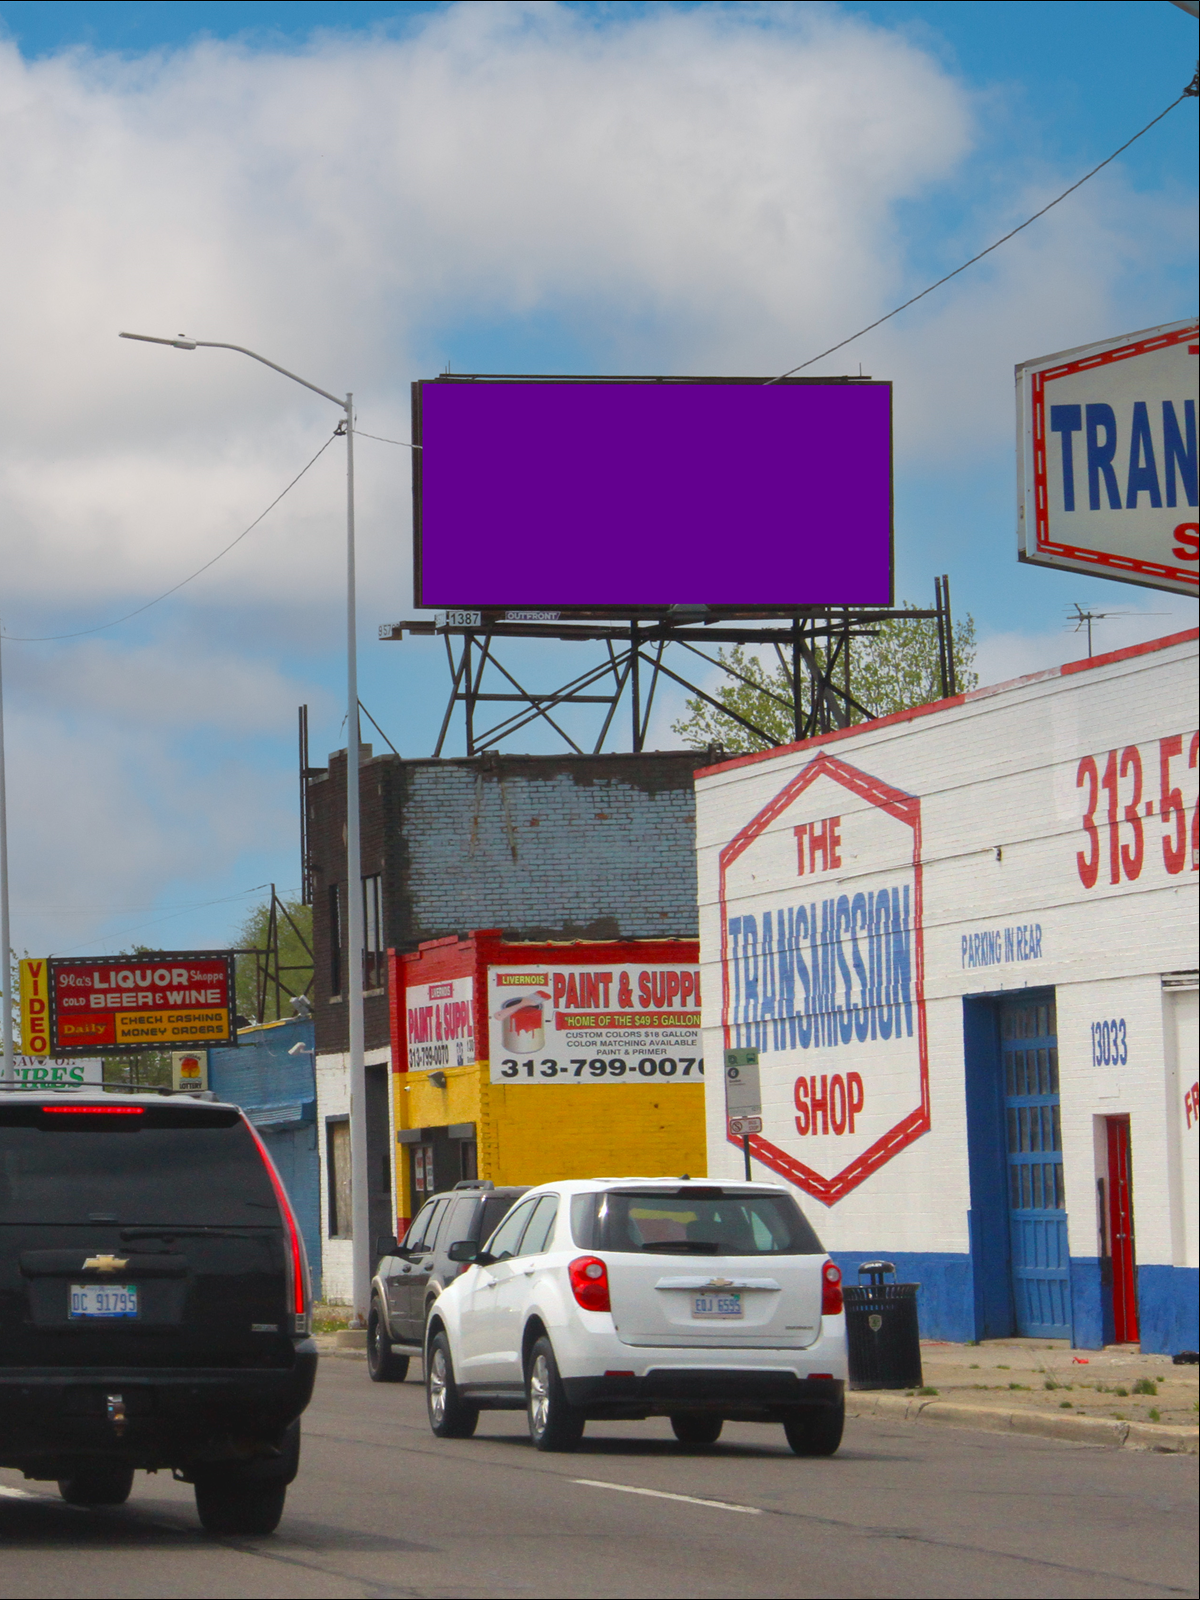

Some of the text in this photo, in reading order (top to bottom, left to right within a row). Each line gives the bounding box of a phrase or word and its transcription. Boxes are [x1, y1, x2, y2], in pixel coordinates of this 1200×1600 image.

[450, 613, 480, 625] 1387
[507, 612, 557, 620] OUTFRONT
[793, 816, 842, 876] THE
[961, 923, 1043, 969] PARKING IN REAR
[93, 968, 189, 988] LIQUOR
[190, 970, 224, 984] Shoppe
[728, 884, 914, 1054] TRANSMISSION
[502, 975, 545, 985] LIVERNOIS
[63, 989, 221, 1008] COLD BEER & WINE
[553, 972, 613, 1009] PAINT
[618, 971, 634, 1009] &
[27, 962, 47, 1053] VIDEO
[121, 1013, 223, 1025] CHECK CASHING
[408, 1005, 433, 1044] PAINT
[435, 1004, 443, 1042] &
[598, 1016, 612, 1027] OF
[614, 1015, 633, 1026] THE
[634, 1015, 651, 1027] $49
[653, 1015, 659, 1026] 5
[63, 1023, 107, 1035] Daily
[121, 1025, 224, 1037] MONEY ORDERS
[565, 1030, 698, 1039] CUSTOM COLORS $18 GALLON
[566, 1040, 598, 1048] COLOR
[649, 1039, 697, 1047] AVAILABLE
[596, 1048, 621, 1056] PAINT
[1090, 1018, 1128, 1067] 13033
[408, 1044, 450, 1068] 313-799-0070
[794, 1072, 864, 1136] SHOP
[96, 1293, 137, 1312] 91795
